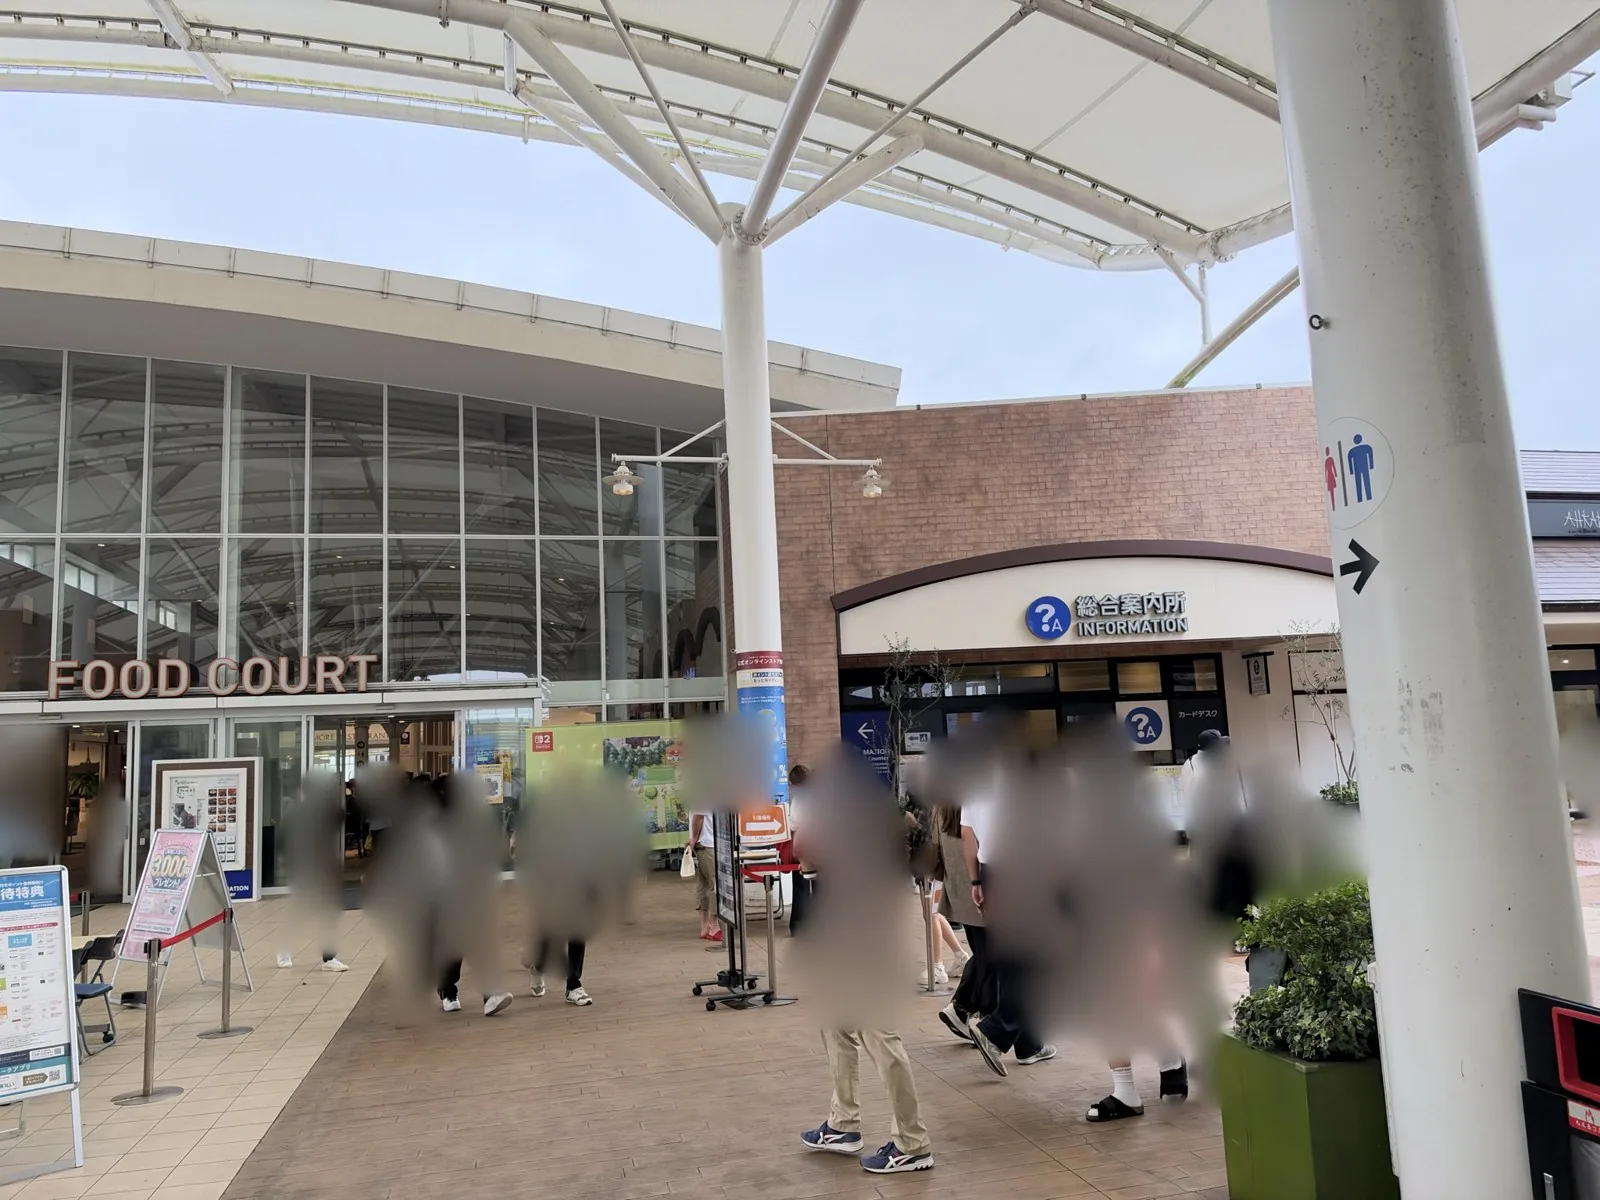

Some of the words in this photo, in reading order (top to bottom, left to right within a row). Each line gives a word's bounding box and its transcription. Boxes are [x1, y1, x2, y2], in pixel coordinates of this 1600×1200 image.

[1075, 590, 1187, 617] 総合案内所
[1076, 617, 1189, 637] INFORMATION
[47, 658, 190, 700] FOOD
[207, 654, 378, 696] COURT
[1178, 710, 1218, 719] カードデスク
